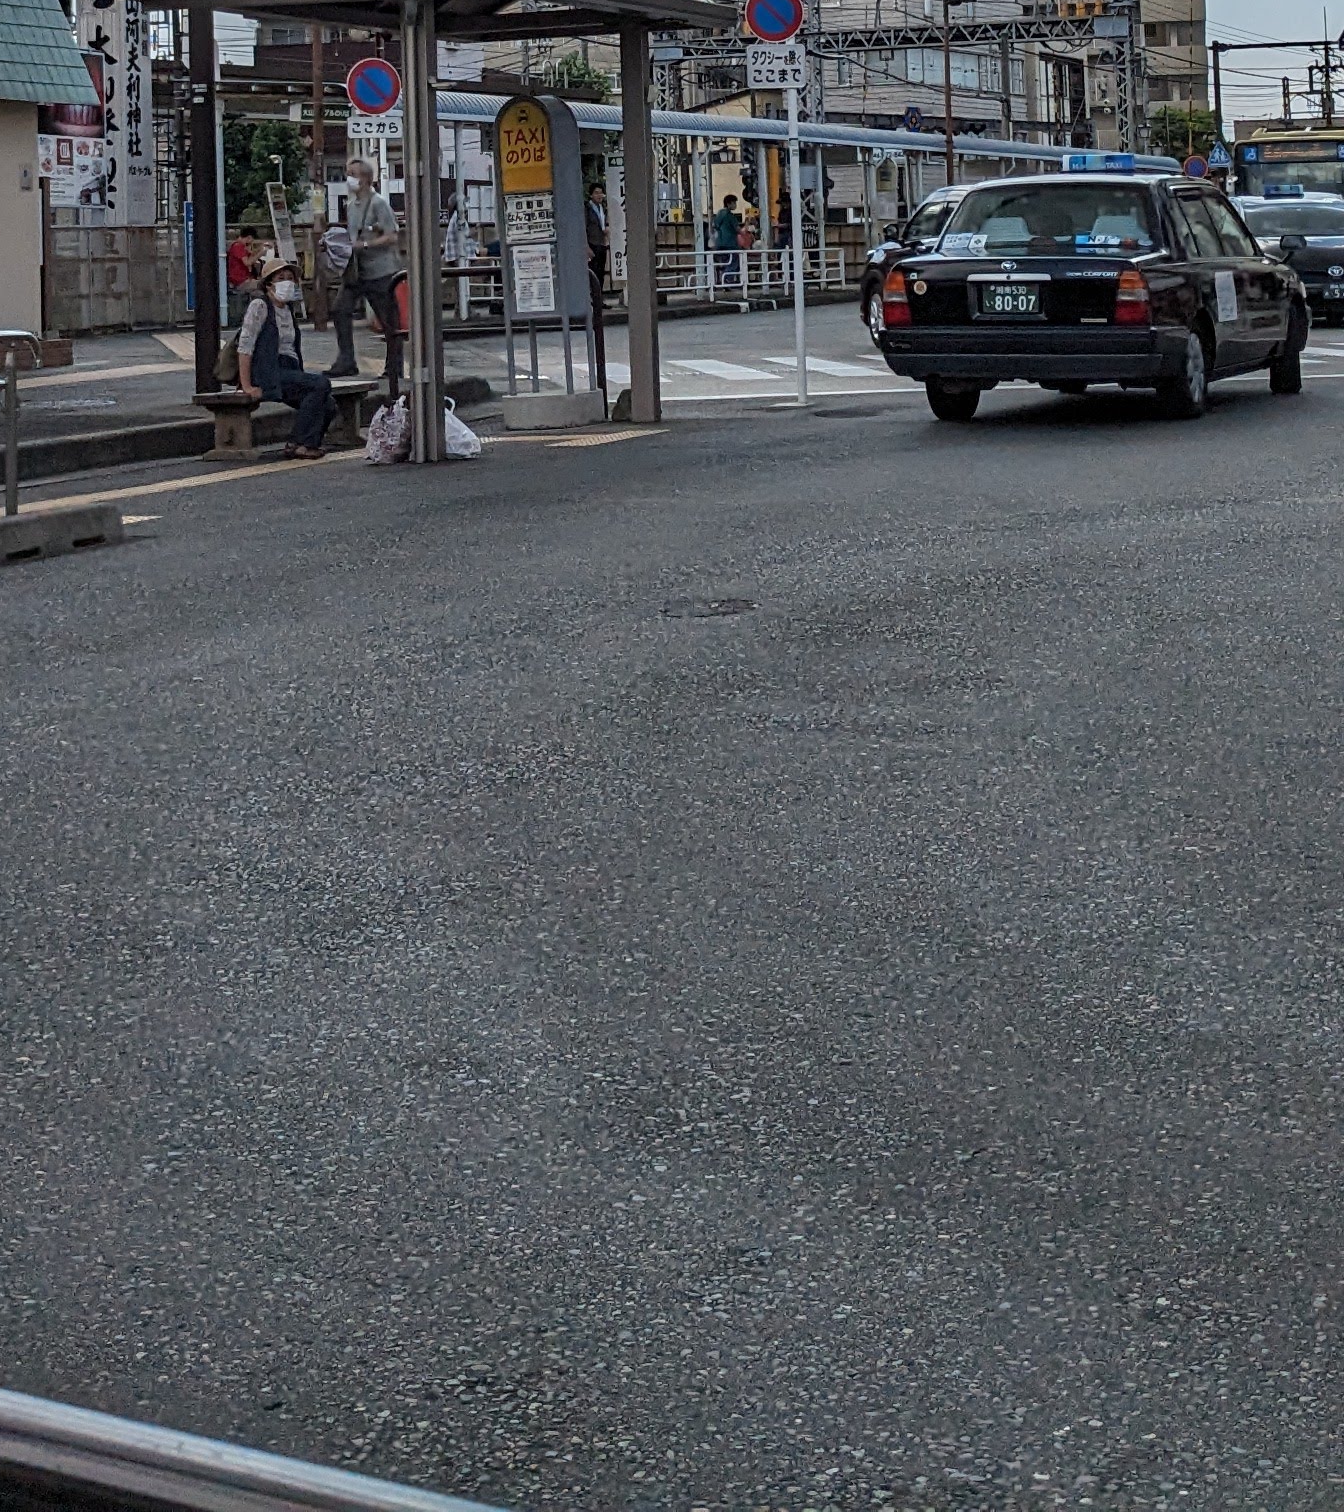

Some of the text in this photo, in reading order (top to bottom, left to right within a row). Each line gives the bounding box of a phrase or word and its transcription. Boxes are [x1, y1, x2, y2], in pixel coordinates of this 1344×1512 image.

[752, 50, 802, 65] タクシーを除く
[752, 69, 802, 83] ここまで
[352, 121, 399, 134] ここから
[504, 126, 546, 146] TAXI
[506, 145, 546, 165] のりば
[614, 251, 623, 277] のりば
[995, 295, 1036, 311] 80-07
